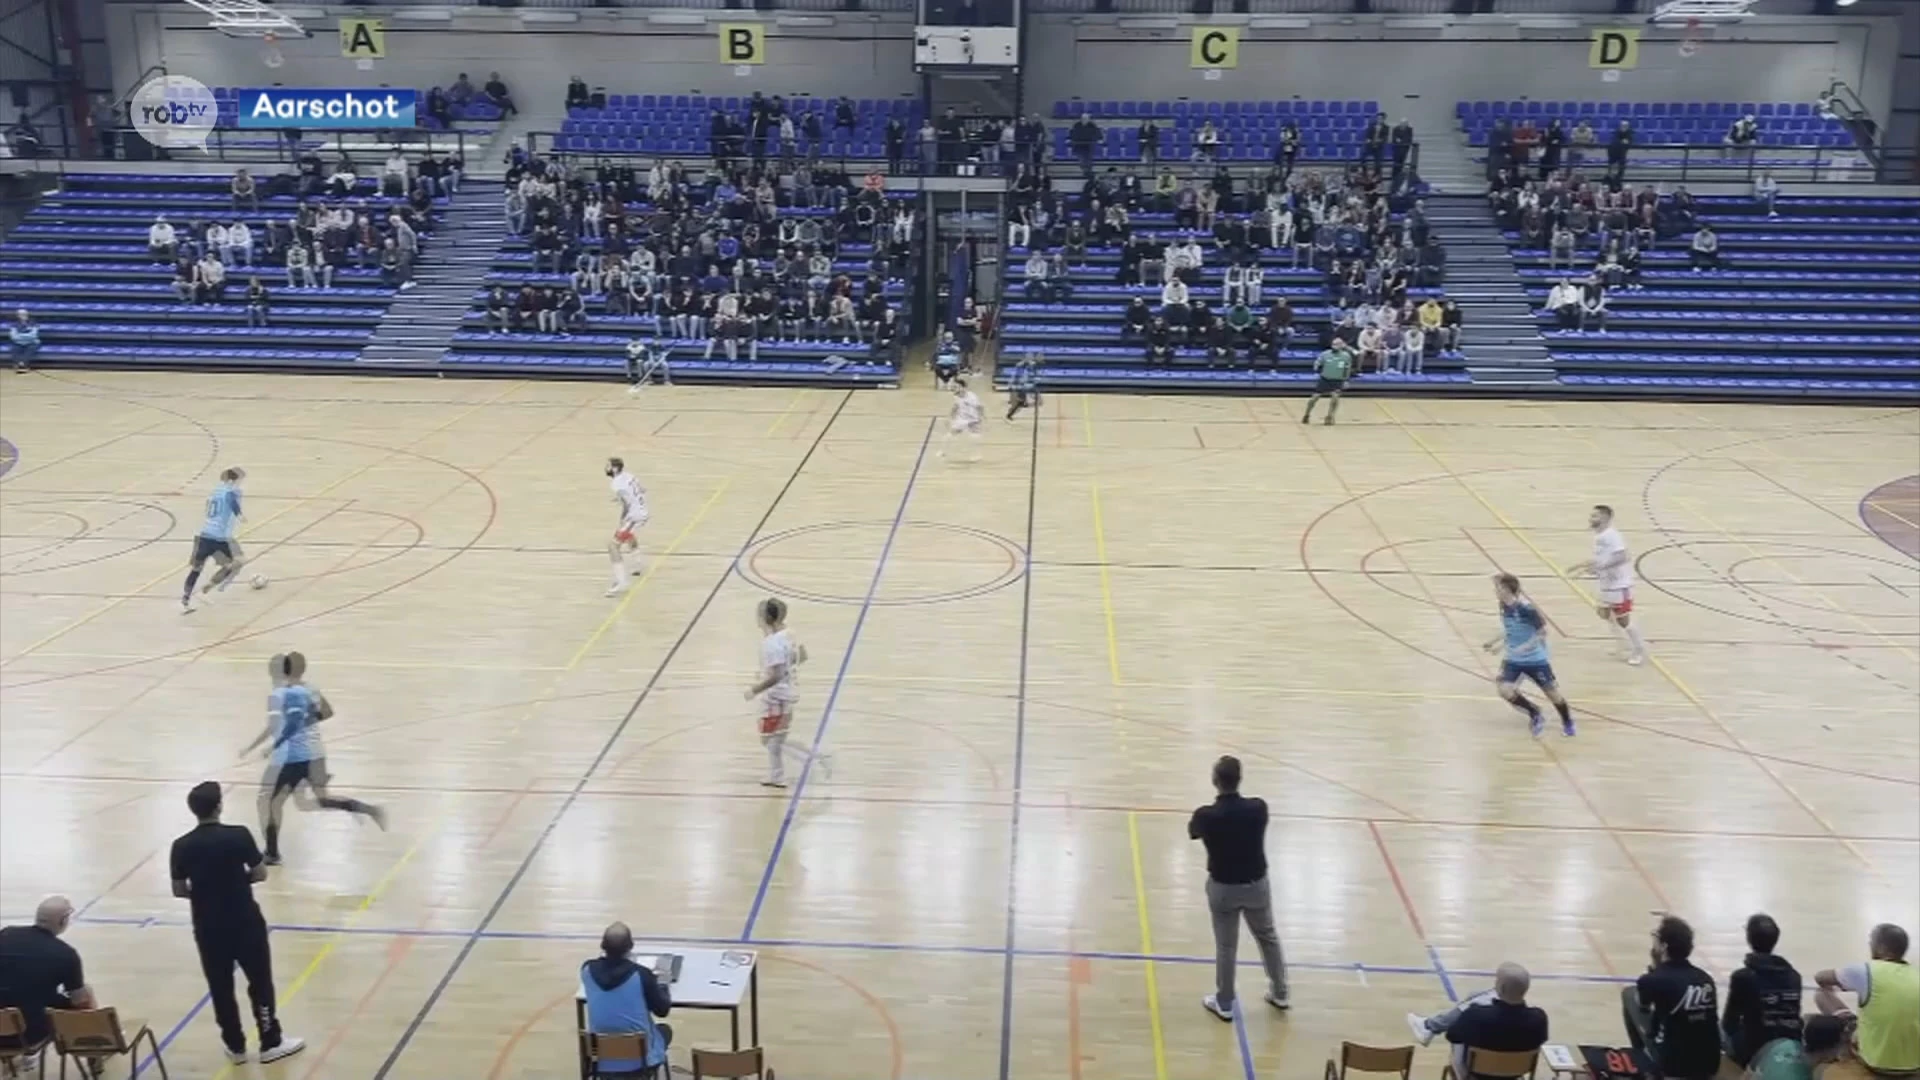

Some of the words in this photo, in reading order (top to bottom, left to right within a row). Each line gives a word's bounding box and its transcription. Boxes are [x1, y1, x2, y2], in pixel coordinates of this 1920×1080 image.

[350, 23, 377, 53] A
[729, 28, 755, 60] B
[1201, 31, 1228, 64] C
[1599, 32, 1629, 64] D
